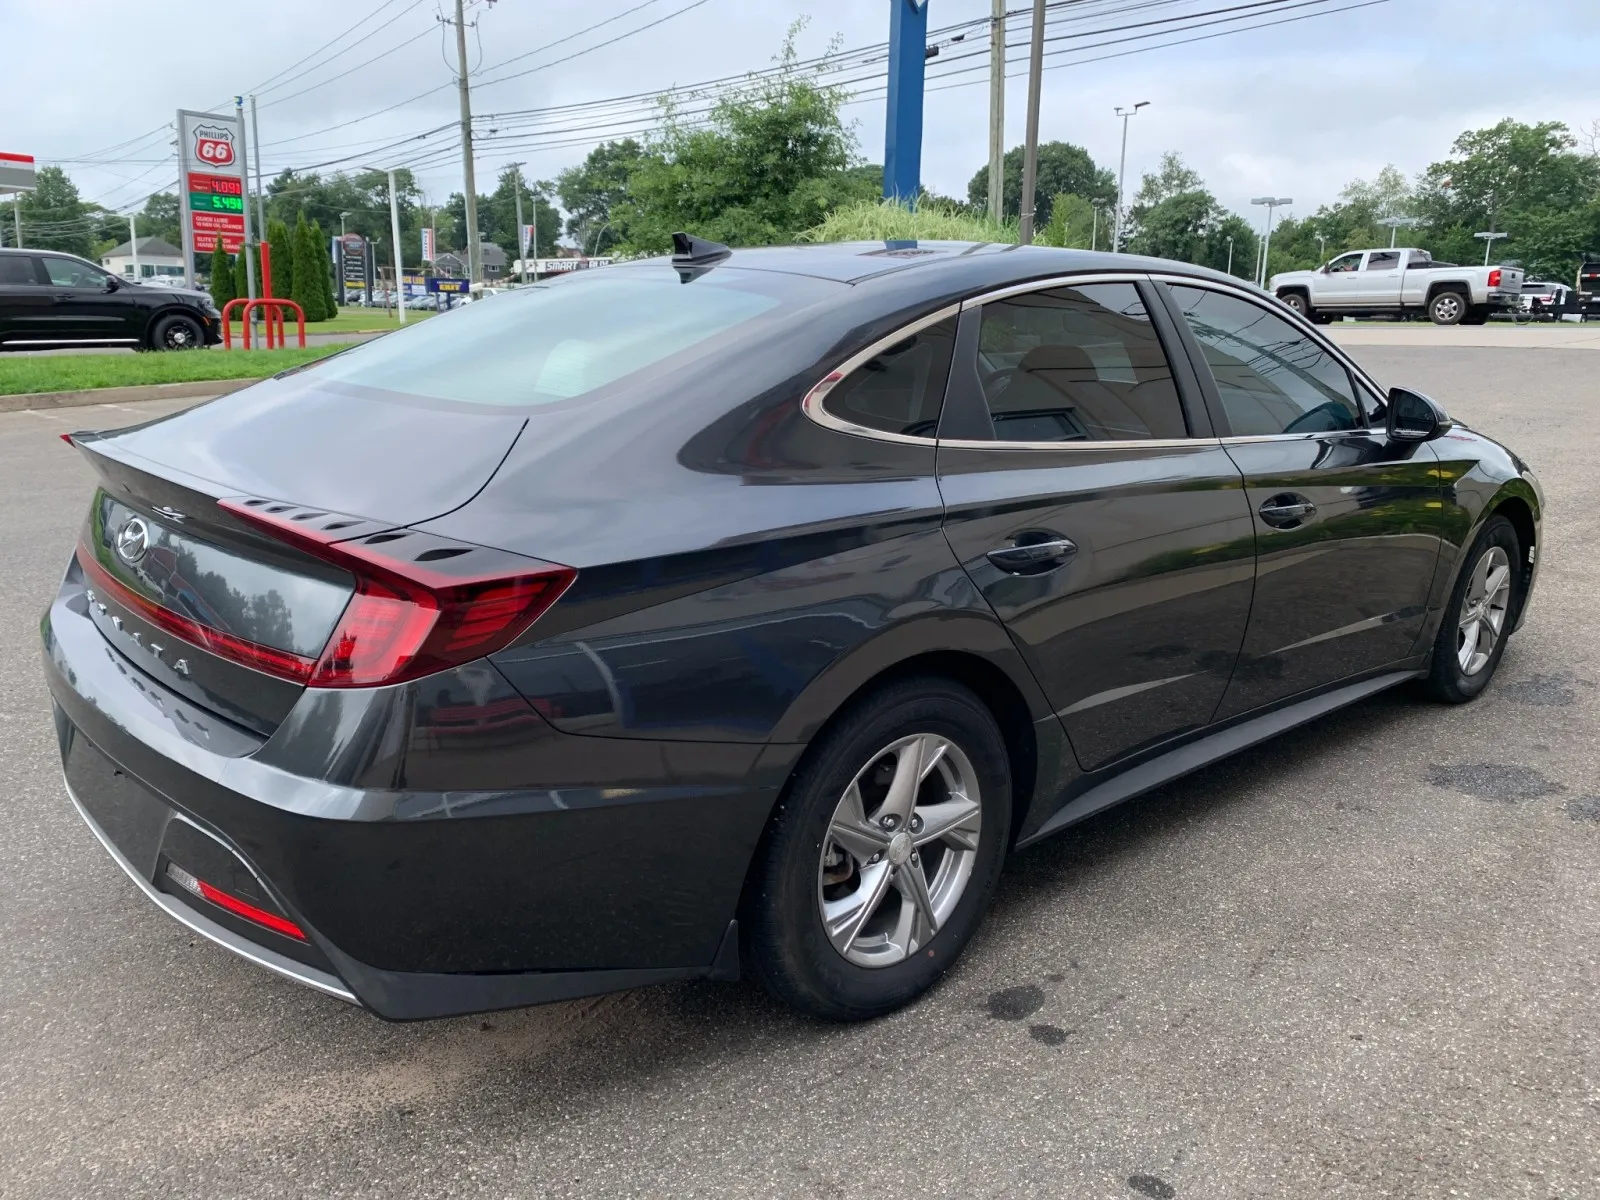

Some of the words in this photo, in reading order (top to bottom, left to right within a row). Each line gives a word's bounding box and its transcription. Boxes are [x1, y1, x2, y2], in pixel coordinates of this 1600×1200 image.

[199, 130, 229, 141] PHILLIPS
[202, 142, 229, 159] 66
[546, 261, 579, 271] SMART
